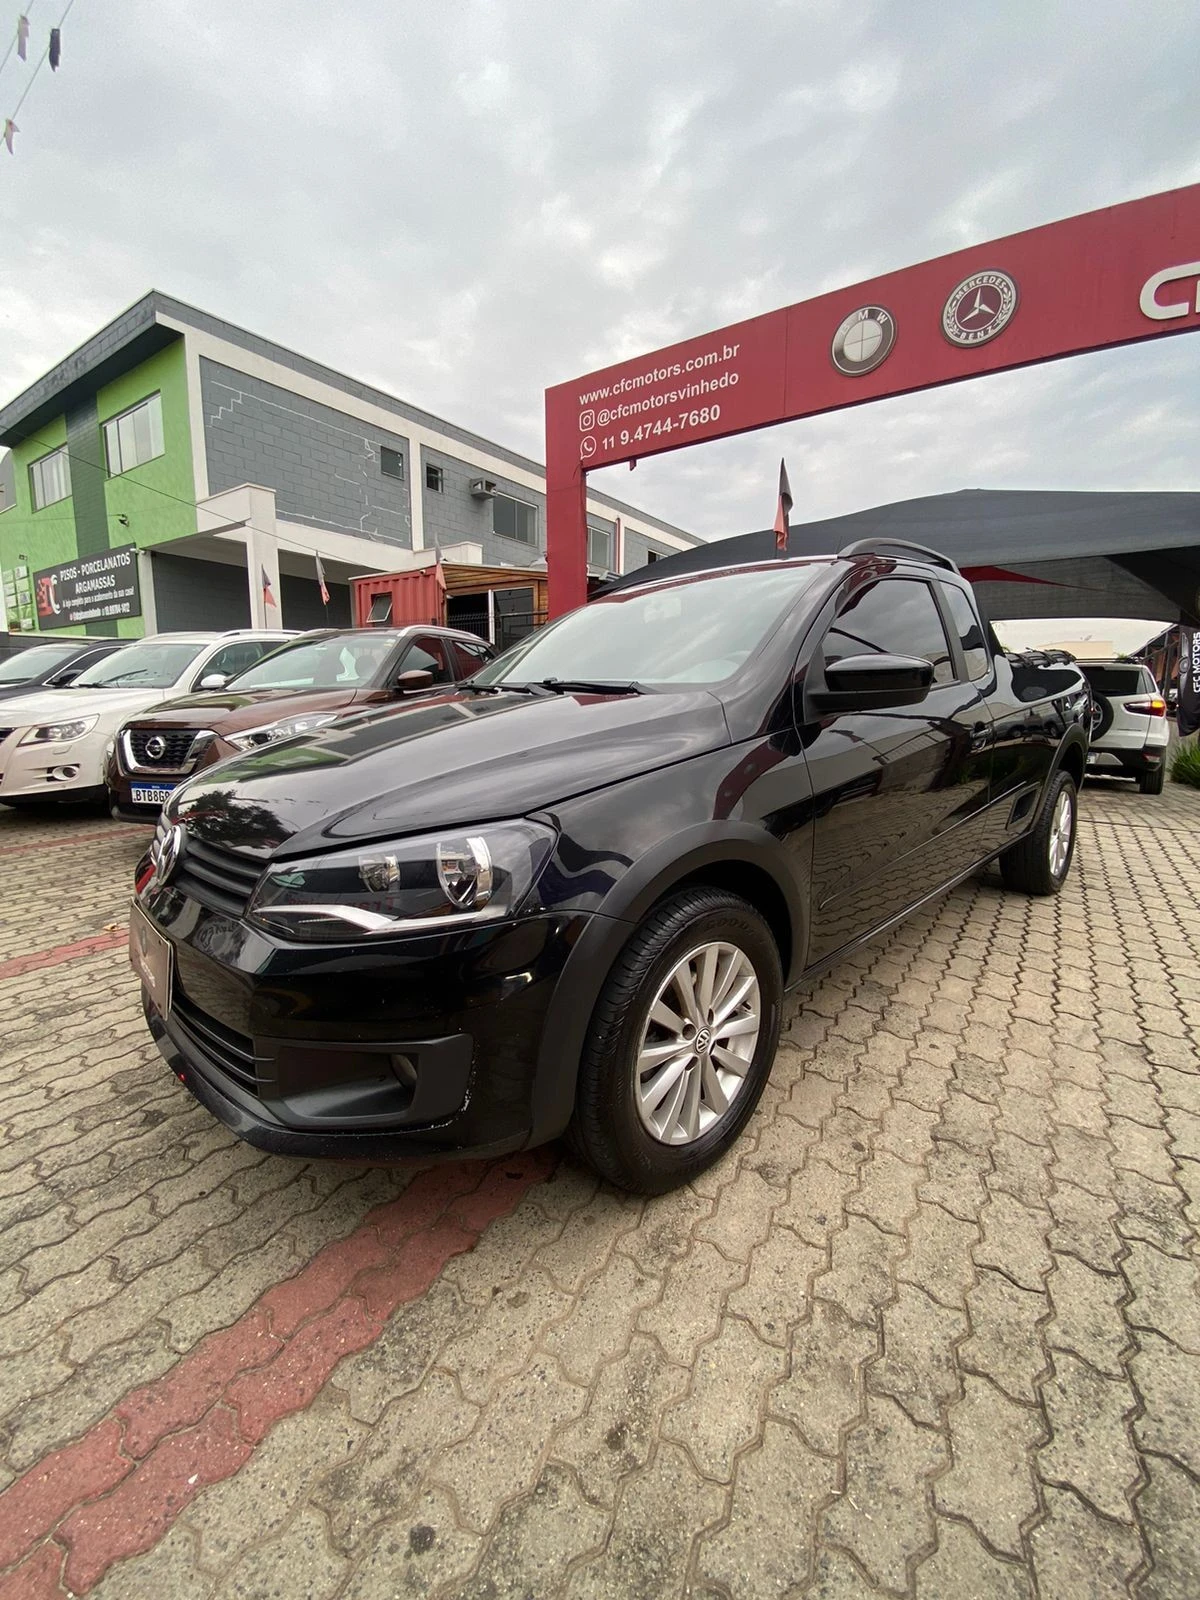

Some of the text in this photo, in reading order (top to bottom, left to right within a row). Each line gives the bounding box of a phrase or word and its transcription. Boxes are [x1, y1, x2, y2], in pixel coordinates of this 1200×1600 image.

[955, 275, 1007, 300] MERCEDES
[960, 326, 993, 340] BENZ
[579, 344, 740, 405] www.cfcmotors.com.br
[597, 372, 739, 427] @cfcmotorsvinhedo
[602, 404, 721, 450] 11 9.4744-7680
[60, 567, 77, 581] PISOS
[81, 552, 131, 576] PORCELANATOS
[75, 575, 116, 594] ARGAMASSAS
[1192, 632, 1200, 674] MOTORS
